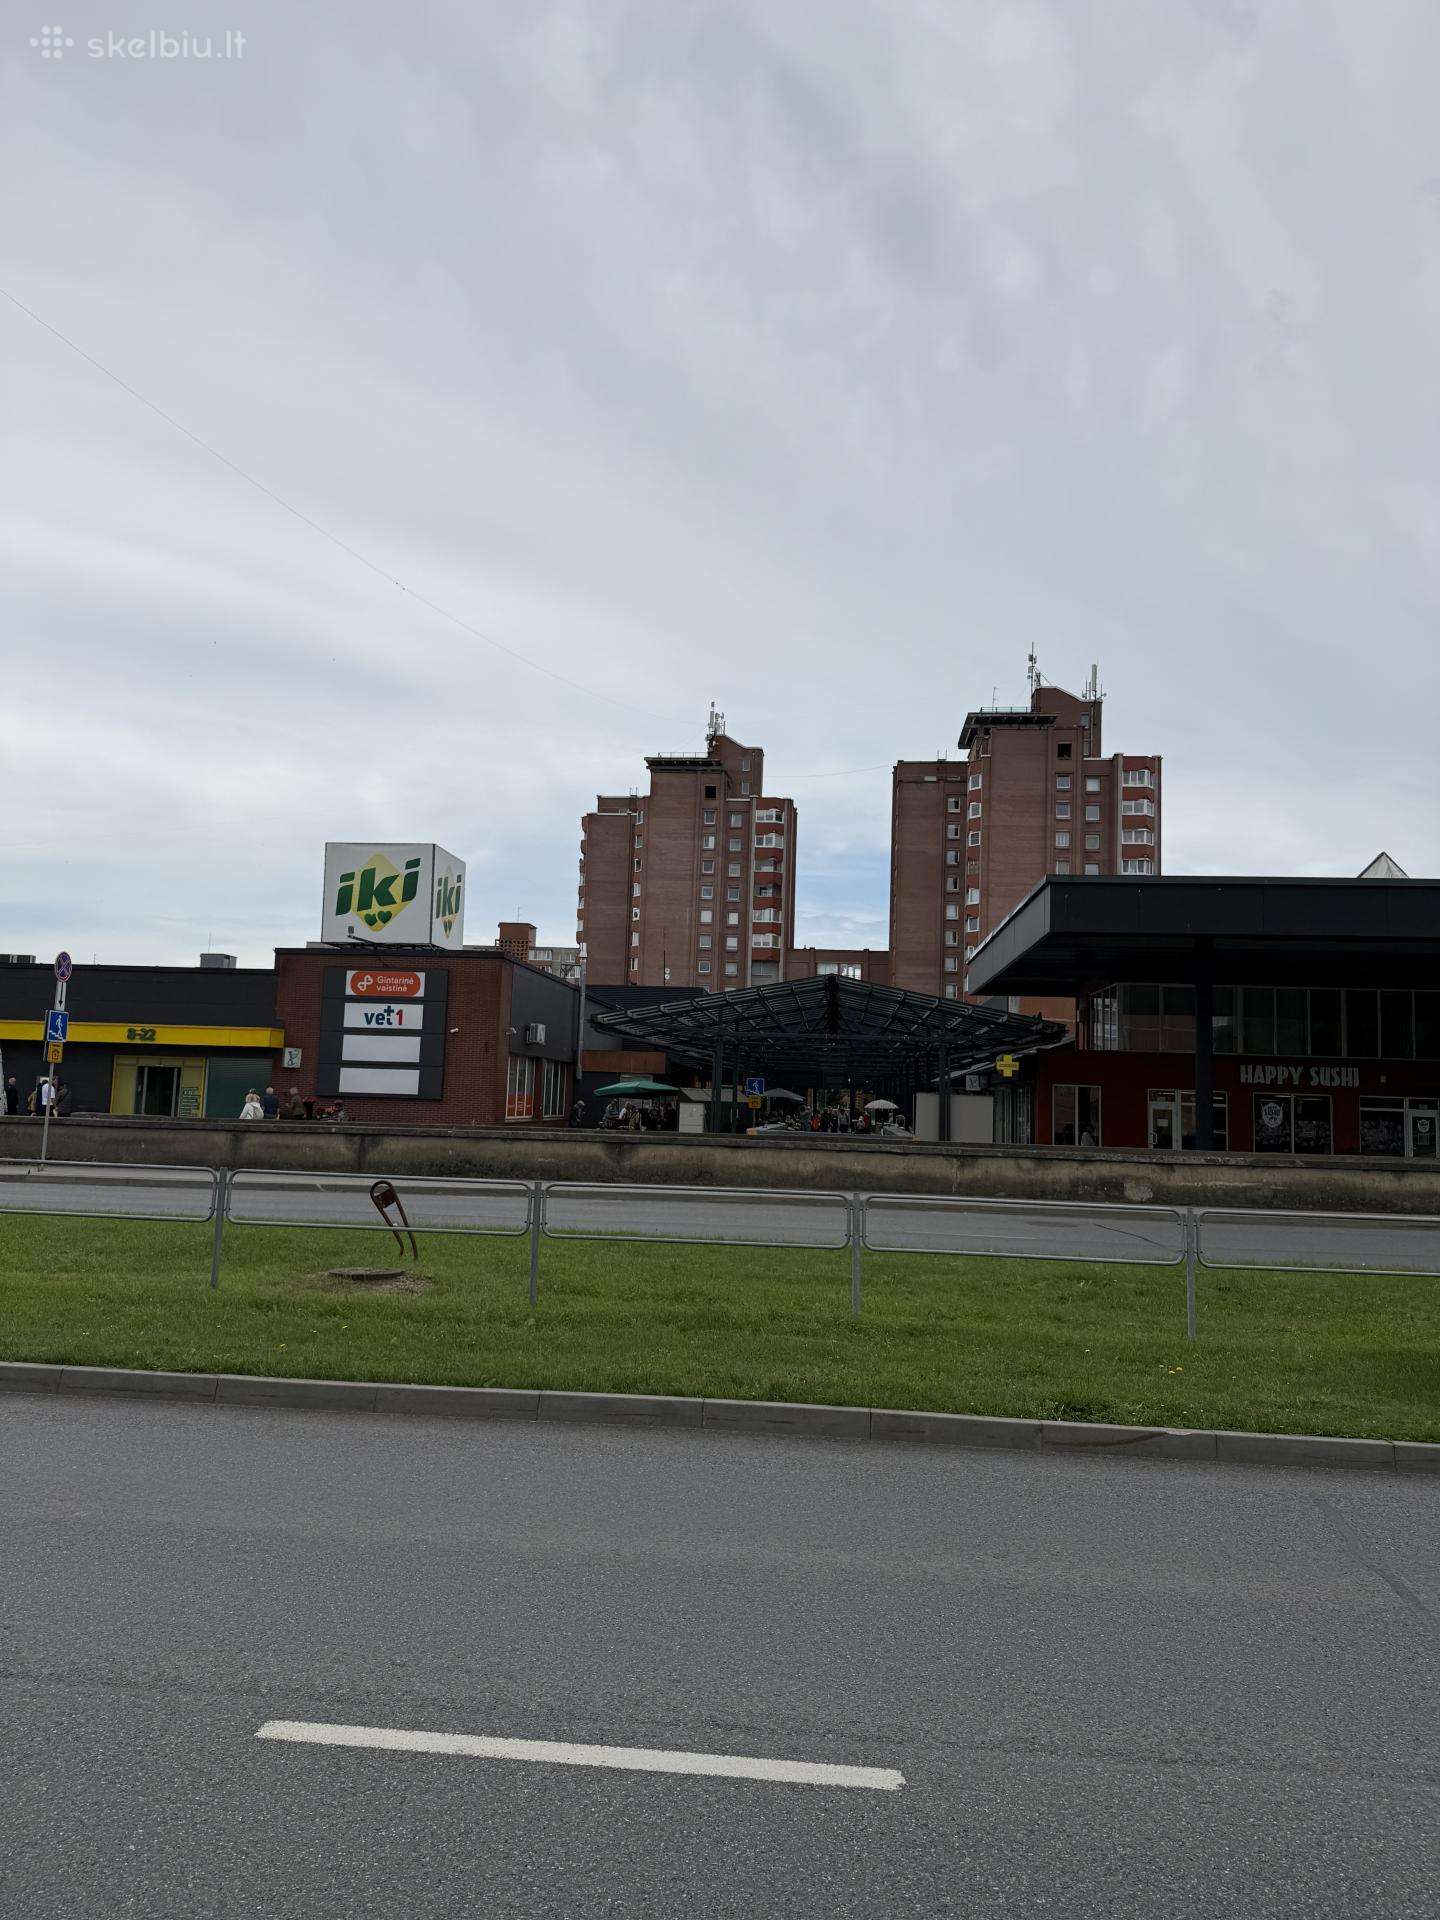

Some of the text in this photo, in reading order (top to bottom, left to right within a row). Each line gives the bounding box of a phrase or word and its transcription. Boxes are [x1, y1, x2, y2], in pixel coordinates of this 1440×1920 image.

[335, 857, 421, 916] iki
[436, 874, 462, 919] iki
[127, 1027, 157, 1040] 8-22
[1239, 1064, 1360, 1088] HAPPY SUSHI
